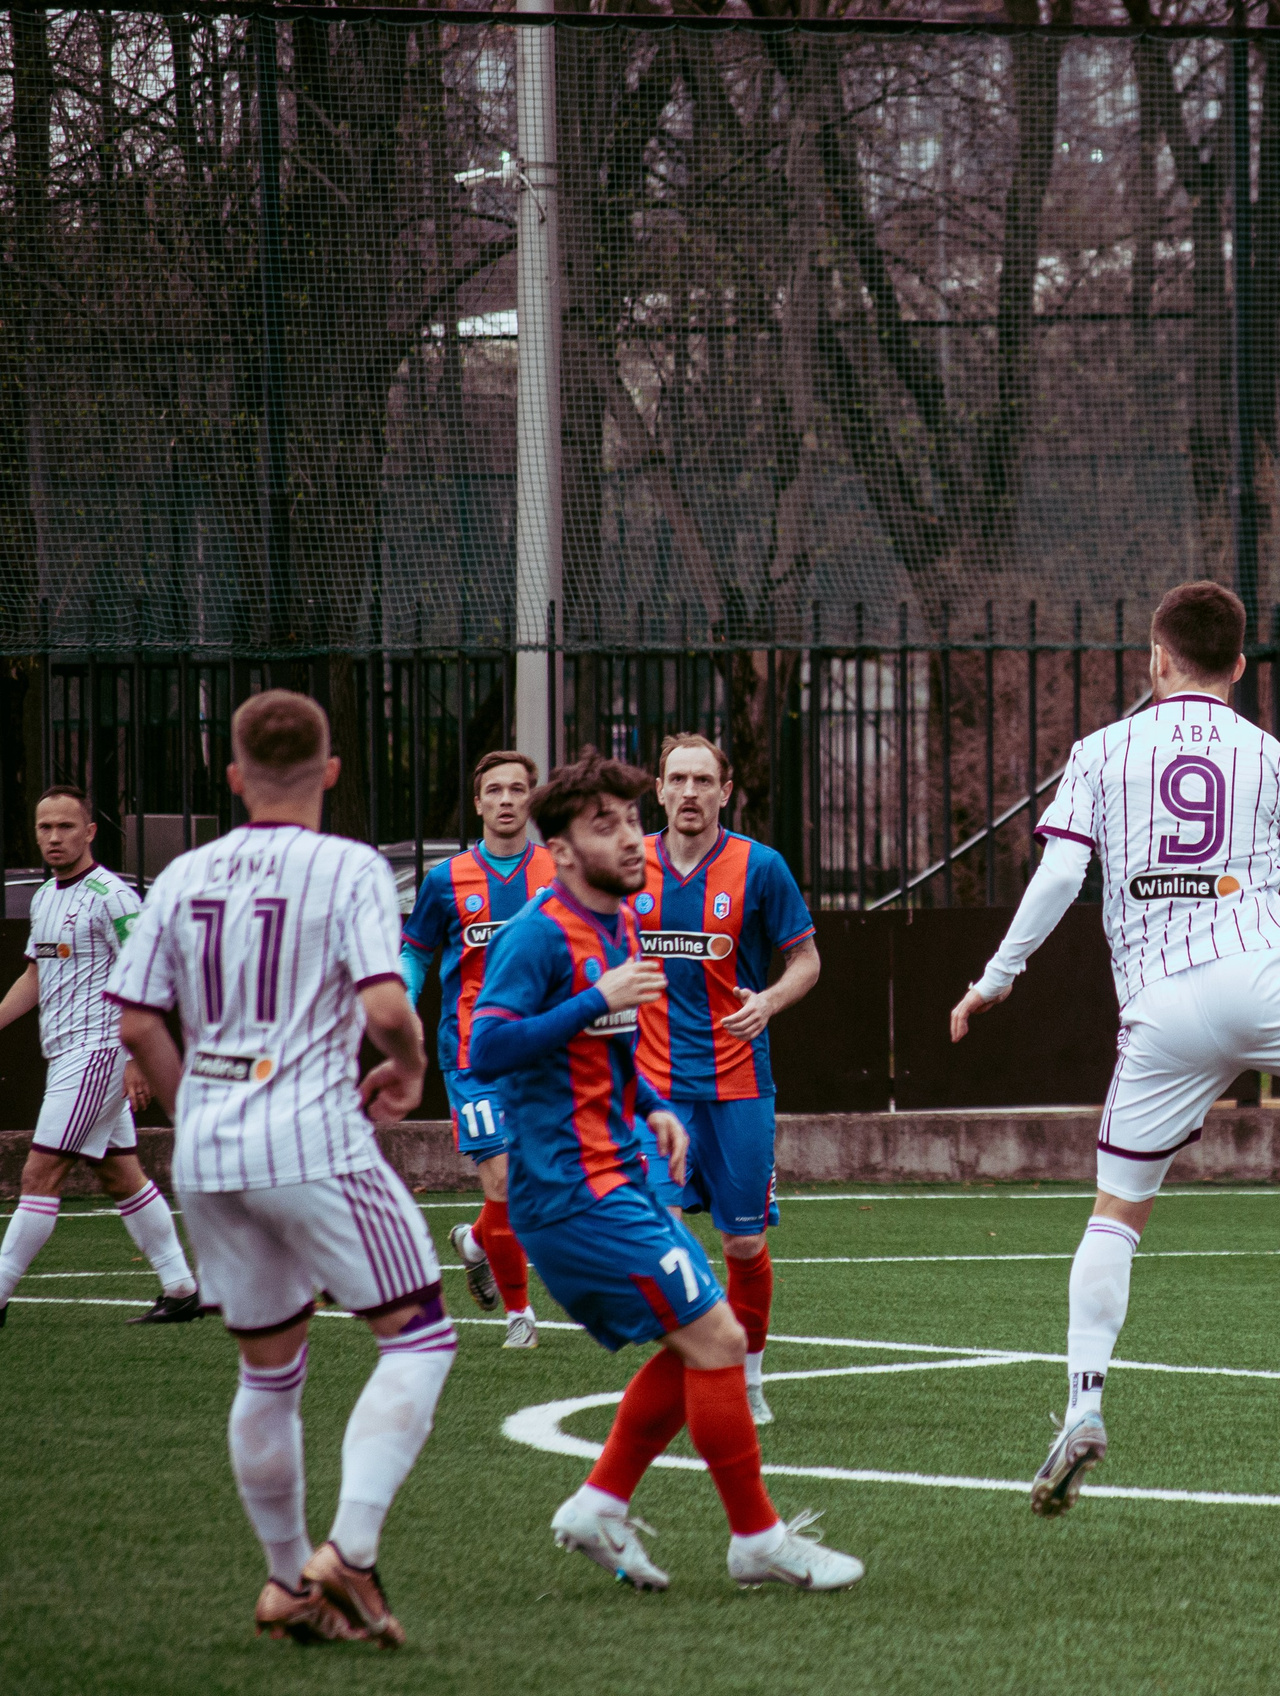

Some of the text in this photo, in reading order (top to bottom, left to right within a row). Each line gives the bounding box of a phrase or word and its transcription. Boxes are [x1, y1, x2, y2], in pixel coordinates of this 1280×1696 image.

[1158, 754, 1226, 865] 9
[1136, 876, 1210, 897] Winline
[191, 897, 288, 1025] 11
[640, 937, 704, 954] Winline
[461, 1099, 496, 1138] 11
[659, 1246, 700, 1304] 7
